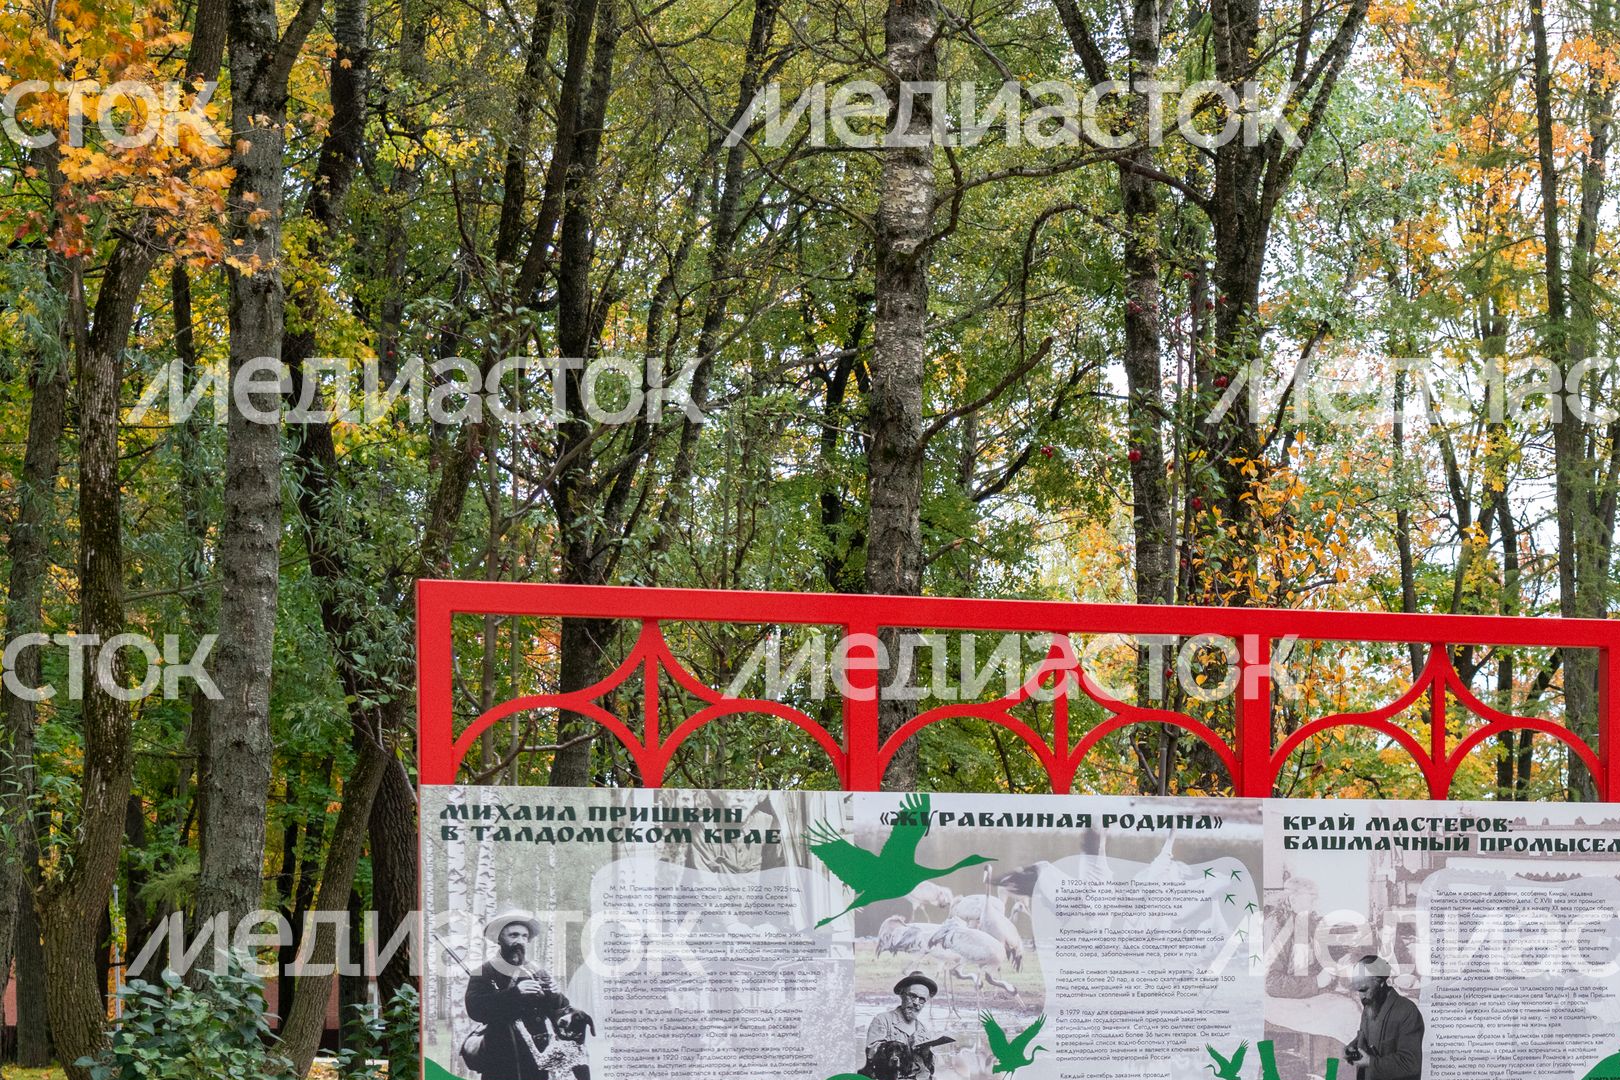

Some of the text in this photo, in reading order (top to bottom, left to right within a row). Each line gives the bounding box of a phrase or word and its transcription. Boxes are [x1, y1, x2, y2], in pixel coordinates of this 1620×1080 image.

[439, 804, 744, 824] МИХАИЛ ПРИШВИН
[880, 809, 1224, 836] «ЖУРАВЛИНАЯ РОДИНА»
[1283, 813, 1514, 832] КРАЙ МАСТЕРОВ:
[441, 825, 782, 844] В ТАЛДОМСКОМ КРАЕ
[1284, 834, 1470, 852] БАШМАЧНЫЙ
